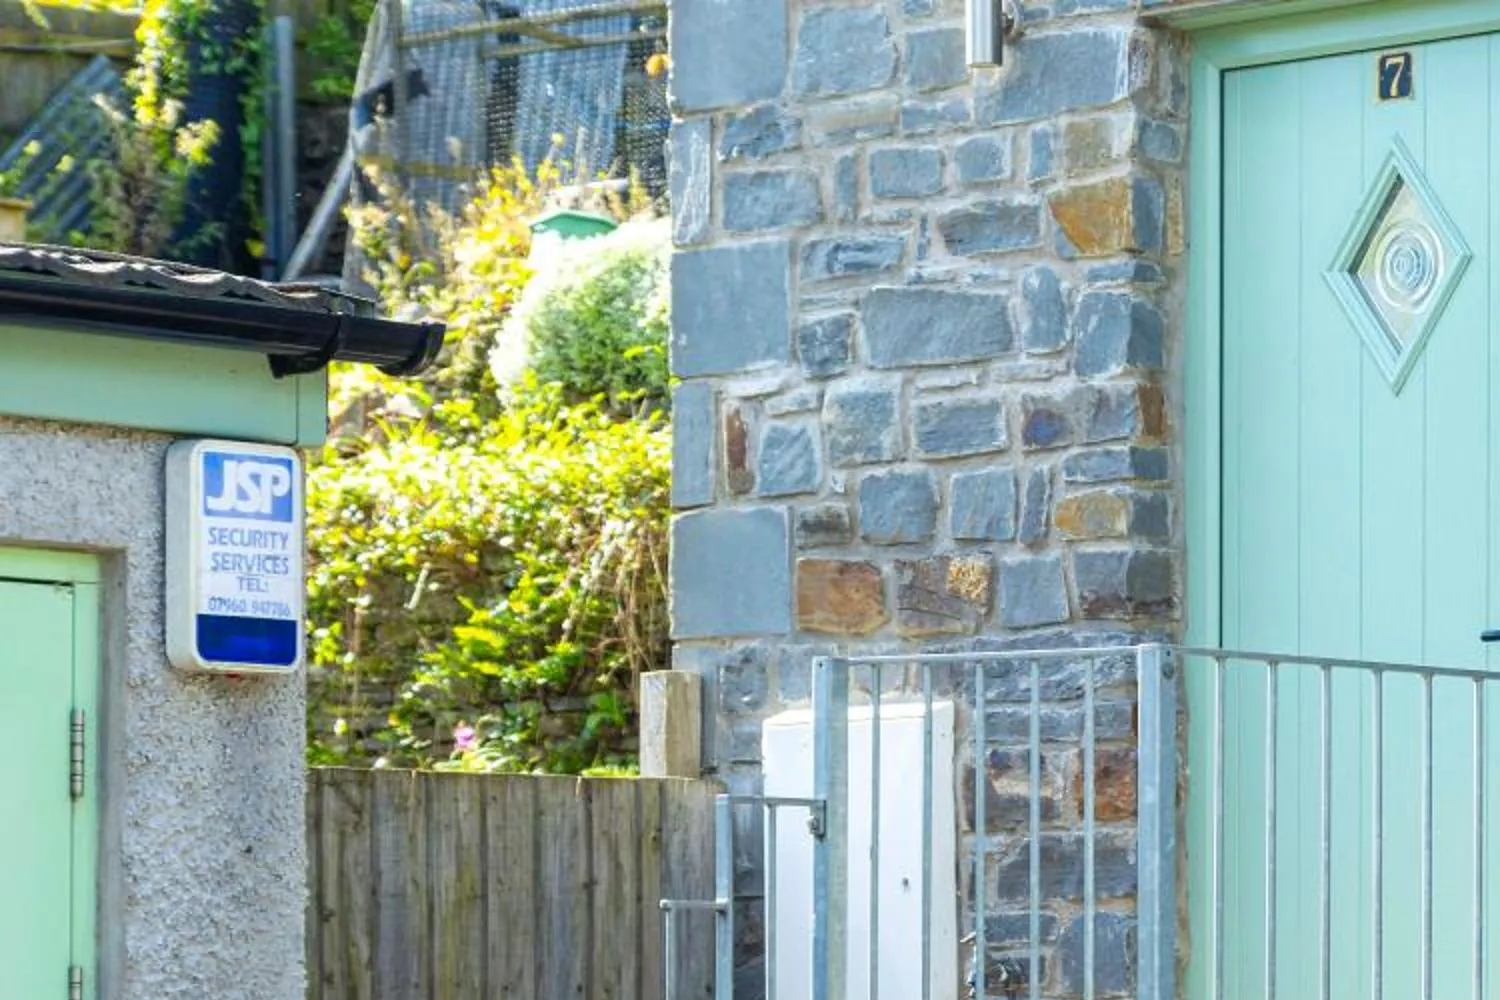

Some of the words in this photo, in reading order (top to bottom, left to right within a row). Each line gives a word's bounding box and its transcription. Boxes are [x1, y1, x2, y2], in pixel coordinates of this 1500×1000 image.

[1385, 56, 1405, 97] 7
[206, 459, 291, 515] JSP
[208, 526, 289, 550] SECURITY
[210, 551, 289, 575] SERVICES
[237, 576, 270, 593] TEL:
